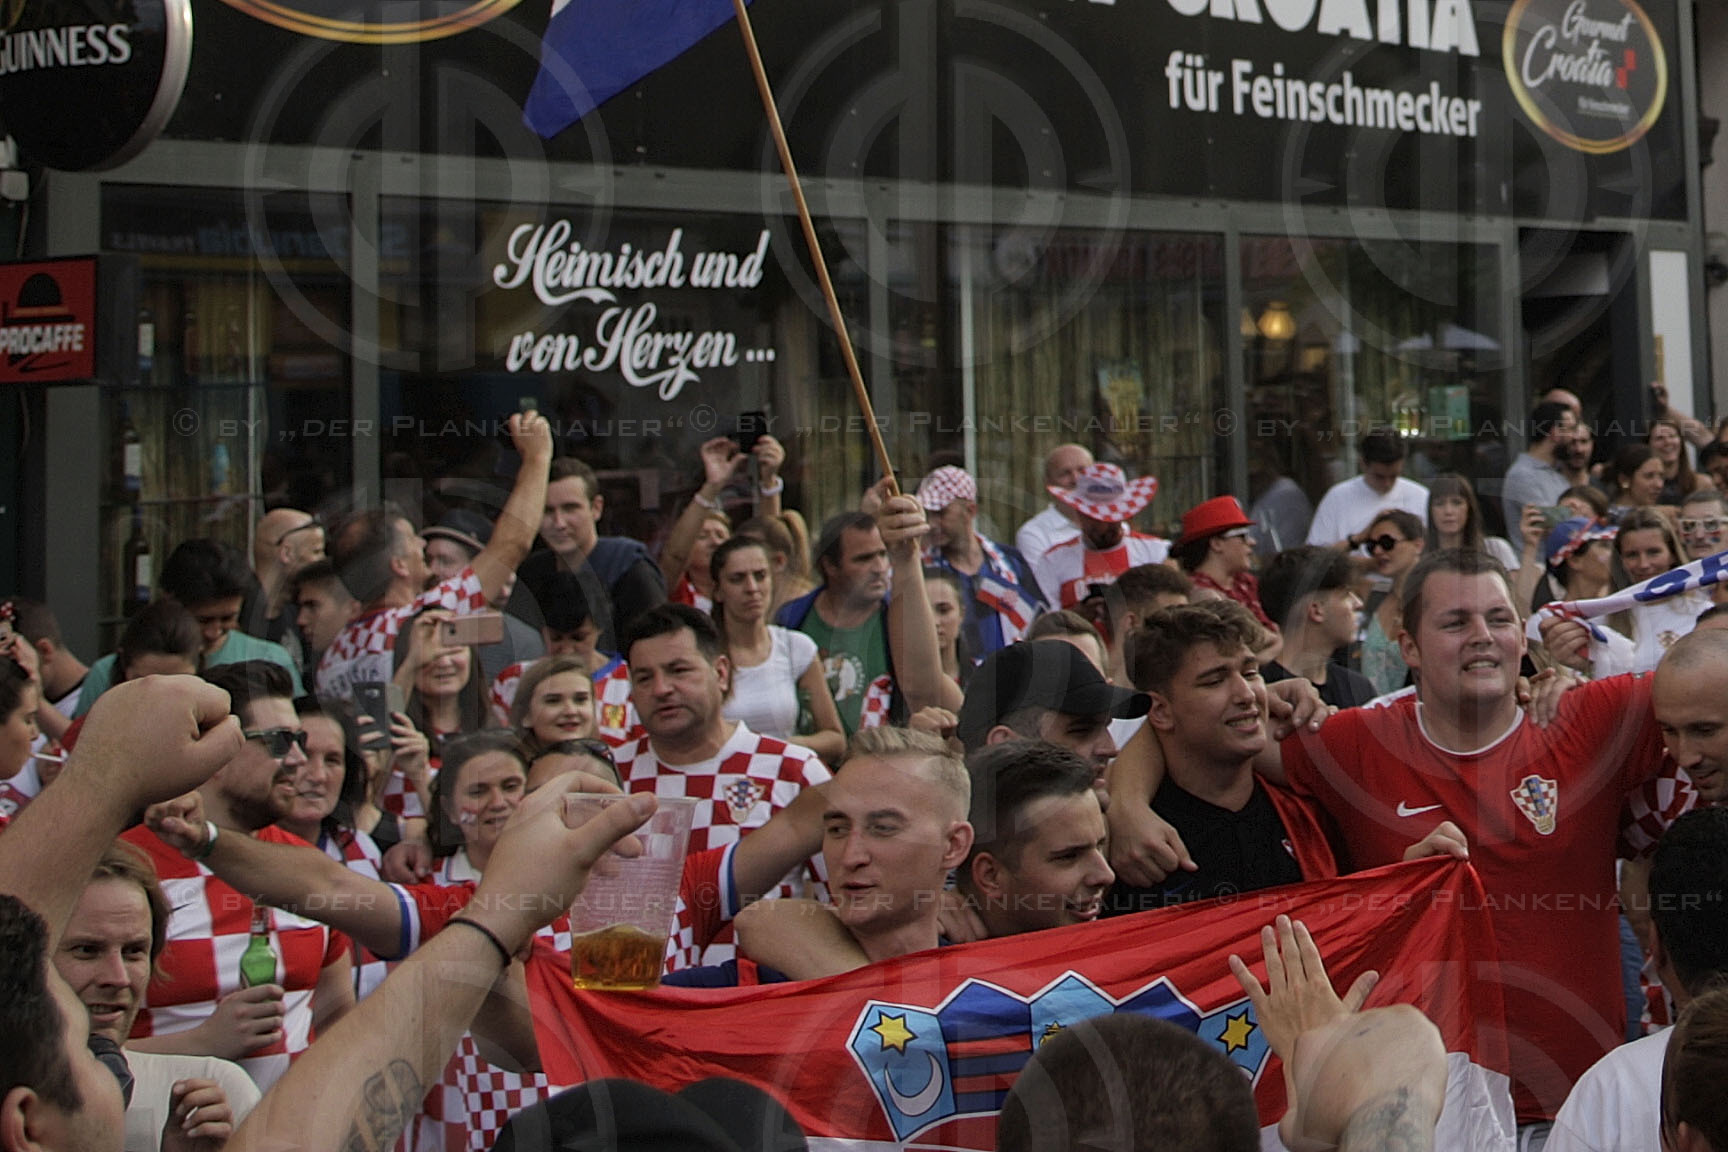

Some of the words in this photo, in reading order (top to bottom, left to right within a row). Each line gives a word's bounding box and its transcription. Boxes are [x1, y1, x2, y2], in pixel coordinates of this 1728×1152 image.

[1165, 50, 1225, 113] für
[1231, 59, 1482, 137] Feinschmecker
[1522, 24, 1614, 88] Croatia
[493, 219, 686, 305] Heimisch
[690, 229, 771, 289] und
[506, 331, 581, 372] von
[583, 302, 738, 401] Herzen
